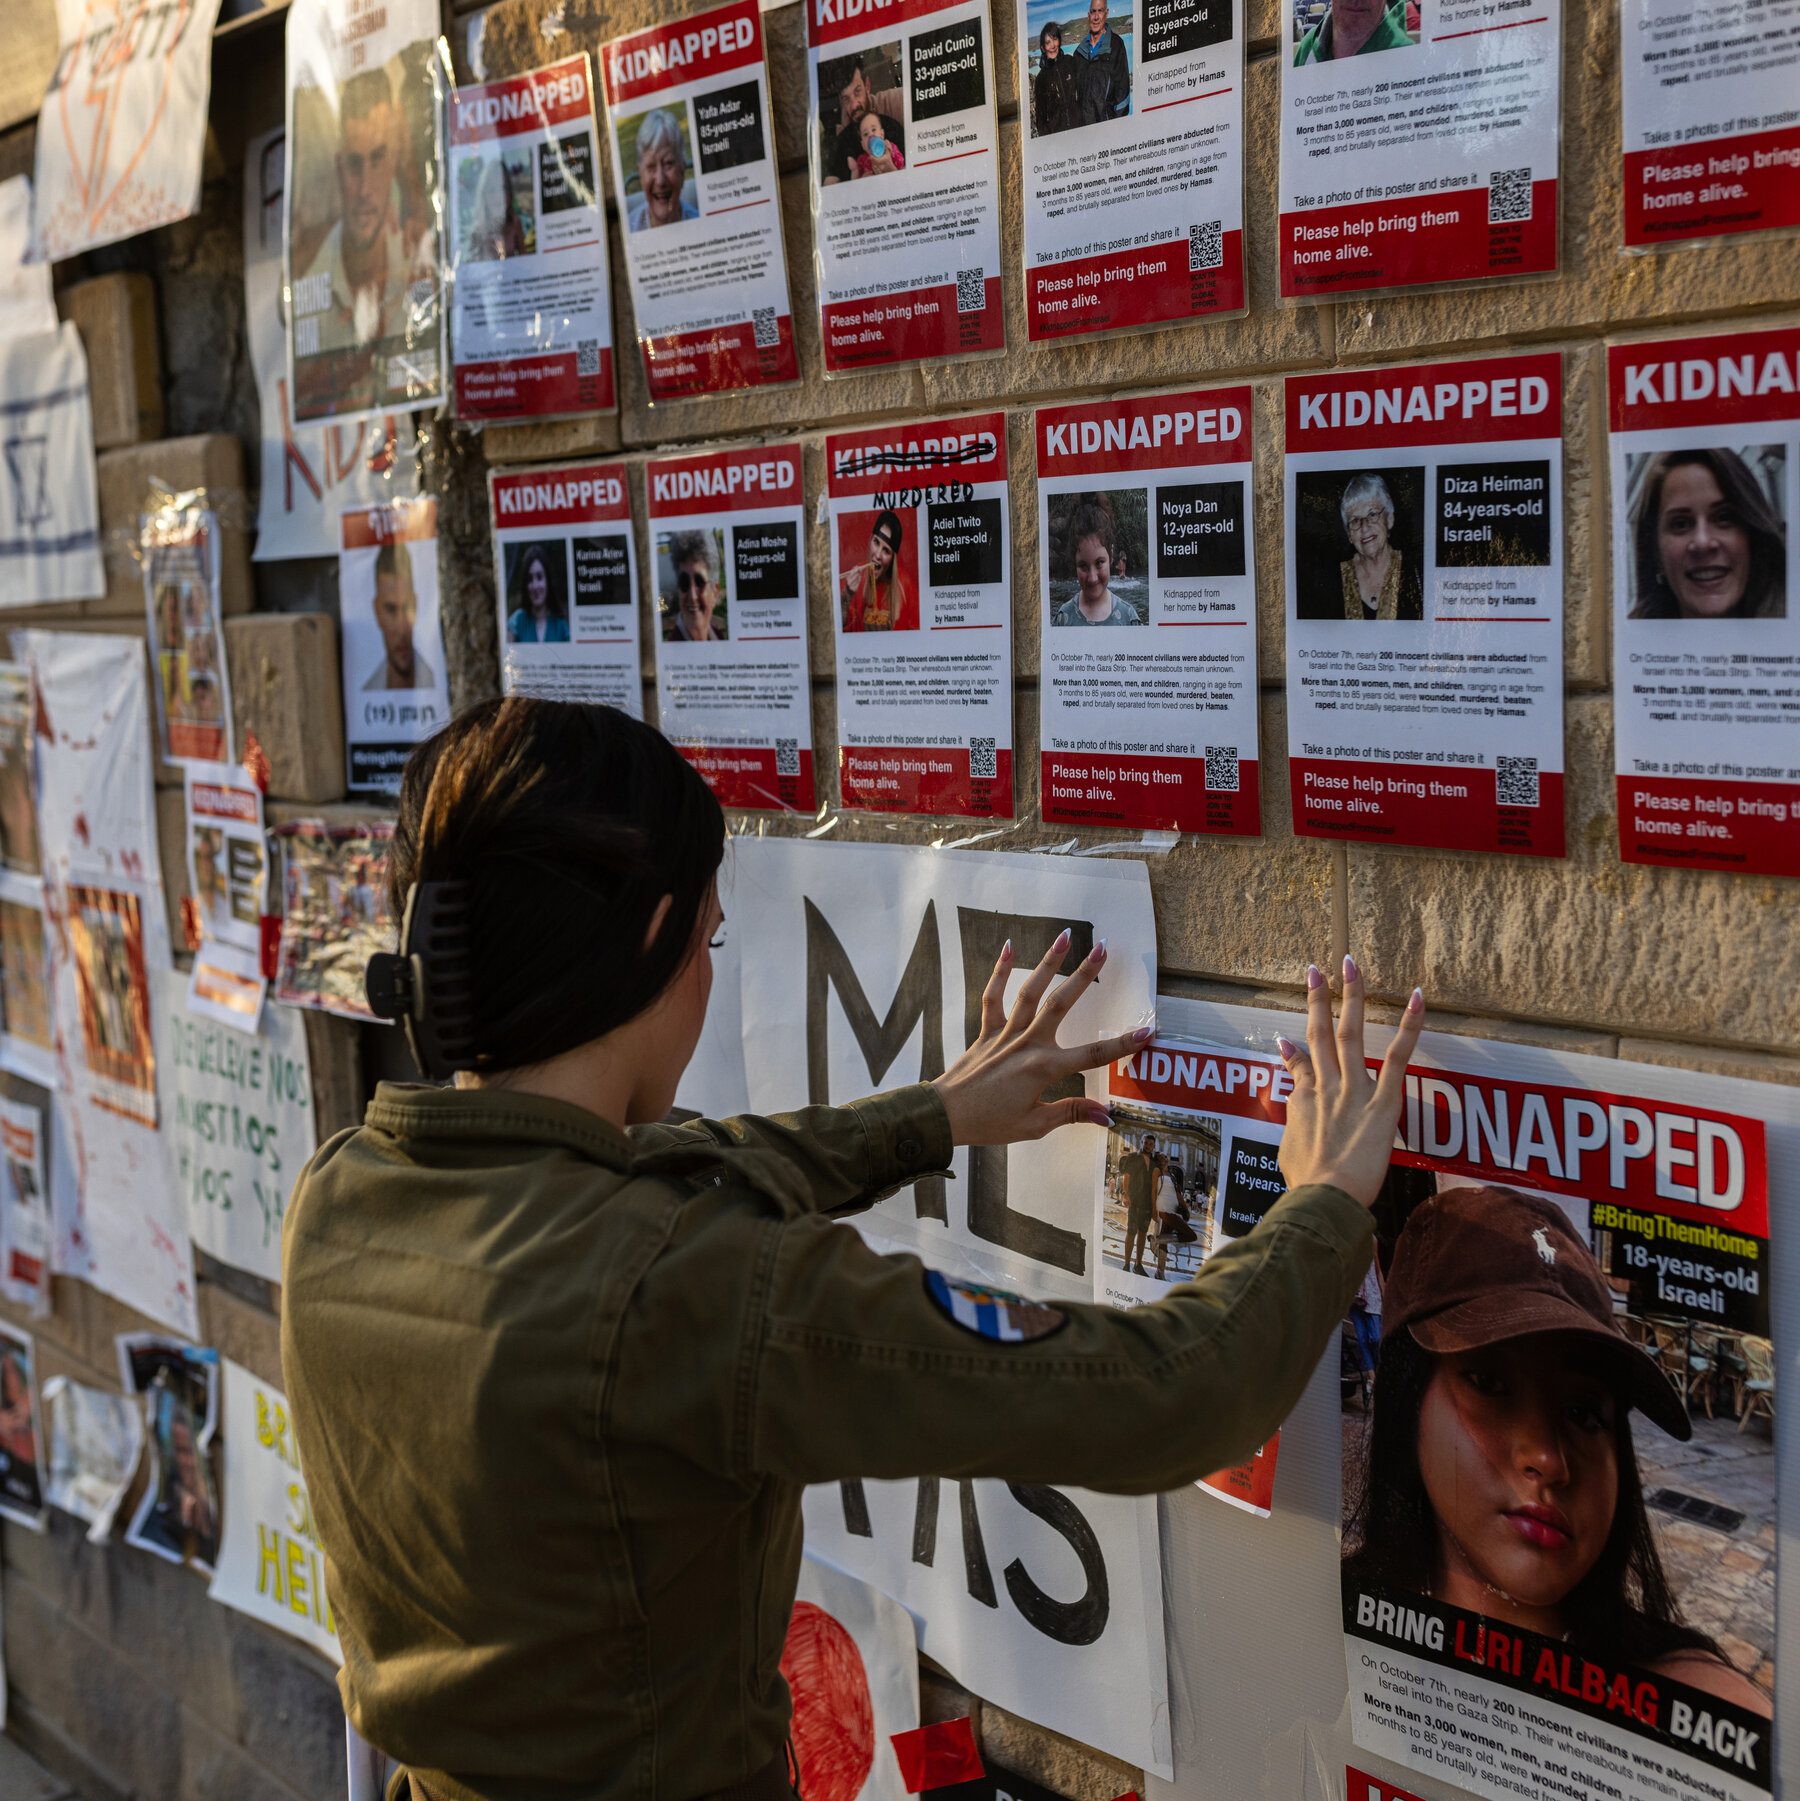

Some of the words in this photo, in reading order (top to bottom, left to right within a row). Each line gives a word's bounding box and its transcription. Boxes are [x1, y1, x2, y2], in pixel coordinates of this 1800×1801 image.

[1149, 3, 1172, 19] Efrat
[1174, 0, 1196, 12] Katz
[1148, 9, 1208, 36] 69-years-old
[609, 17, 755, 86] KIDNAPPED
[915, 42, 943, 62] David
[945, 36, 975, 53] Cunio
[1149, 35, 1178, 54] Israeli
[916, 53, 977, 82] 33-years-old
[1148, 65, 1188, 82] Kidnapped
[1190, 61, 1206, 71] from
[916, 82, 946, 101] Israeli
[1148, 85, 1164, 96] their
[1166, 80, 1186, 90] home
[1187, 78, 1197, 87] by
[1200, 70, 1226, 83] Hamas
[457, 72, 585, 130] KIDNAPPED
[918, 126, 950, 140] Kidnapped
[951, 123, 966, 133] from
[928, 141, 945, 150] home
[946, 138, 955, 148] by
[955, 133, 978, 145] Hamas
[1643, 164, 1704, 185] Please
[1709, 154, 1750, 174] help
[1643, 189, 1700, 210] home
[1699, 182, 1749, 203] alive.
[1294, 226, 1339, 242] Please
[1344, 219, 1374, 237] help
[1379, 215, 1417, 232] bring
[1421, 211, 1459, 227] them
[1294, 250, 1332, 265] home
[1336, 244, 1372, 260] alive.
[1038, 278, 1073, 294] Please
[1077, 271, 1101, 287] help
[1104, 266, 1134, 282] bring
[1137, 261, 1166, 276] them
[1299, 376, 1550, 430] KIDNAPPED
[1046, 407, 1243, 457] KIDNAPPED
[834, 432, 997, 480] KIDNAPPED
[654, 460, 795, 502] KIDNAPPED
[1445, 478, 1478, 494] Diza
[1483, 476, 1543, 492] Heiman
[500, 478, 623, 514] KIDNAPPED
[873, 480, 975, 510] MURDERED
[1163, 502, 1192, 518] Noya
[1195, 499, 1218, 514] Dan
[1444, 499, 1542, 520] 84-years-old
[933, 517, 956, 531] Adiel
[957, 516, 982, 528] Twito
[1164, 519, 1233, 538] 12-years-old
[738, 539, 760, 550] Adina
[761, 536, 788, 548] Moshe
[934, 532, 987, 549] 33-years-old
[1444, 526, 1492, 543] Israeli
[934, 550, 960, 564] Israeli
[1164, 542, 1198, 556] Israeli
[739, 568, 762, 580] Israeli
[935, 590, 966, 600] Kidnapped
[967, 588, 981, 598] from
[1164, 588, 1203, 600] Kidnapped
[1204, 588, 1221, 598] from
[935, 604, 939, 612] a
[940, 602, 957, 611] music
[958, 601, 979, 611] festival
[1164, 604, 1176, 612] her
[1177, 603, 1197, 612] home
[1198, 602, 1208, 614] by
[1209, 602, 1236, 611] Hamas
[935, 615, 943, 625] by
[944, 614, 965, 623] Hamas
[1053, 678, 1068, 687] More
[1068, 678, 1082, 687] than
[1083, 678, 1099, 687] 3,000
[1141, 680, 1153, 688] and
[1183, 682, 1207, 690] ranging
[1214, 682, 1227, 691] age
[1228, 681, 1243, 689] from
[1052, 738, 1069, 749] Take
[1070, 741, 1076, 749] a
[1077, 739, 1098, 751] photo
[1099, 740, 1107, 750] of
[1108, 740, 1123, 751] this
[1124, 742, 1148, 753] poster
[1149, 742, 1165, 753] and
[1166, 742, 1189, 754] share
[1190, 743, 1196, 754] it
[1304, 773, 1349, 789] Please
[1354, 776, 1384, 795] help
[1388, 778, 1425, 798] bring
[1430, 781, 1467, 797] them
[1305, 794, 1343, 810] home
[1347, 798, 1383, 813] alive.
[1117, 1050, 1295, 1103] KIDNAPPE
[1394, 1075, 1746, 1211] IDNAPPED
[1236, 1150, 1258, 1168] Ron
[1593, 1204, 1759, 1260] #BringThemHome
[1623, 1243, 1760, 1296] 18-years-old
[1658, 1278, 1725, 1314] Israeli
[1356, 1594, 1445, 1652] BRING
[1454, 1620, 1522, 1676] LIRI
[1533, 1650, 1659, 1728] ALBAG
[1670, 1701, 1760, 1771] BACK
[1361, 1655, 1378, 1671] On
[1380, 1660, 1425, 1687] October
[1454, 1687, 1490, 1707] nearly
[1493, 1700, 1515, 1716] 200
[1518, 1706, 1573, 1738] innocent
[1577, 1730, 1628, 1760] civilians
[1632, 1752, 1663, 1774] were
[1666, 1768, 1726, 1801] abducted
[1364, 1693, 1392, 1712] More
[1395, 1704, 1421, 1723] than
[1425, 1715, 1457, 1735] 3,000
[1544, 1759, 1567, 1777] and
[1379, 1677, 1408, 1696] Israel
[1412, 1688, 1433, 1705] into
[1436, 1696, 1454, 1711] the
[1457, 1705, 1488, 1723] Gaza
[1525, 1726, 1554, 1747] Their
[1558, 1741, 1634, 1780] whereabouts
[1637, 1774, 1679, 1798] remain
